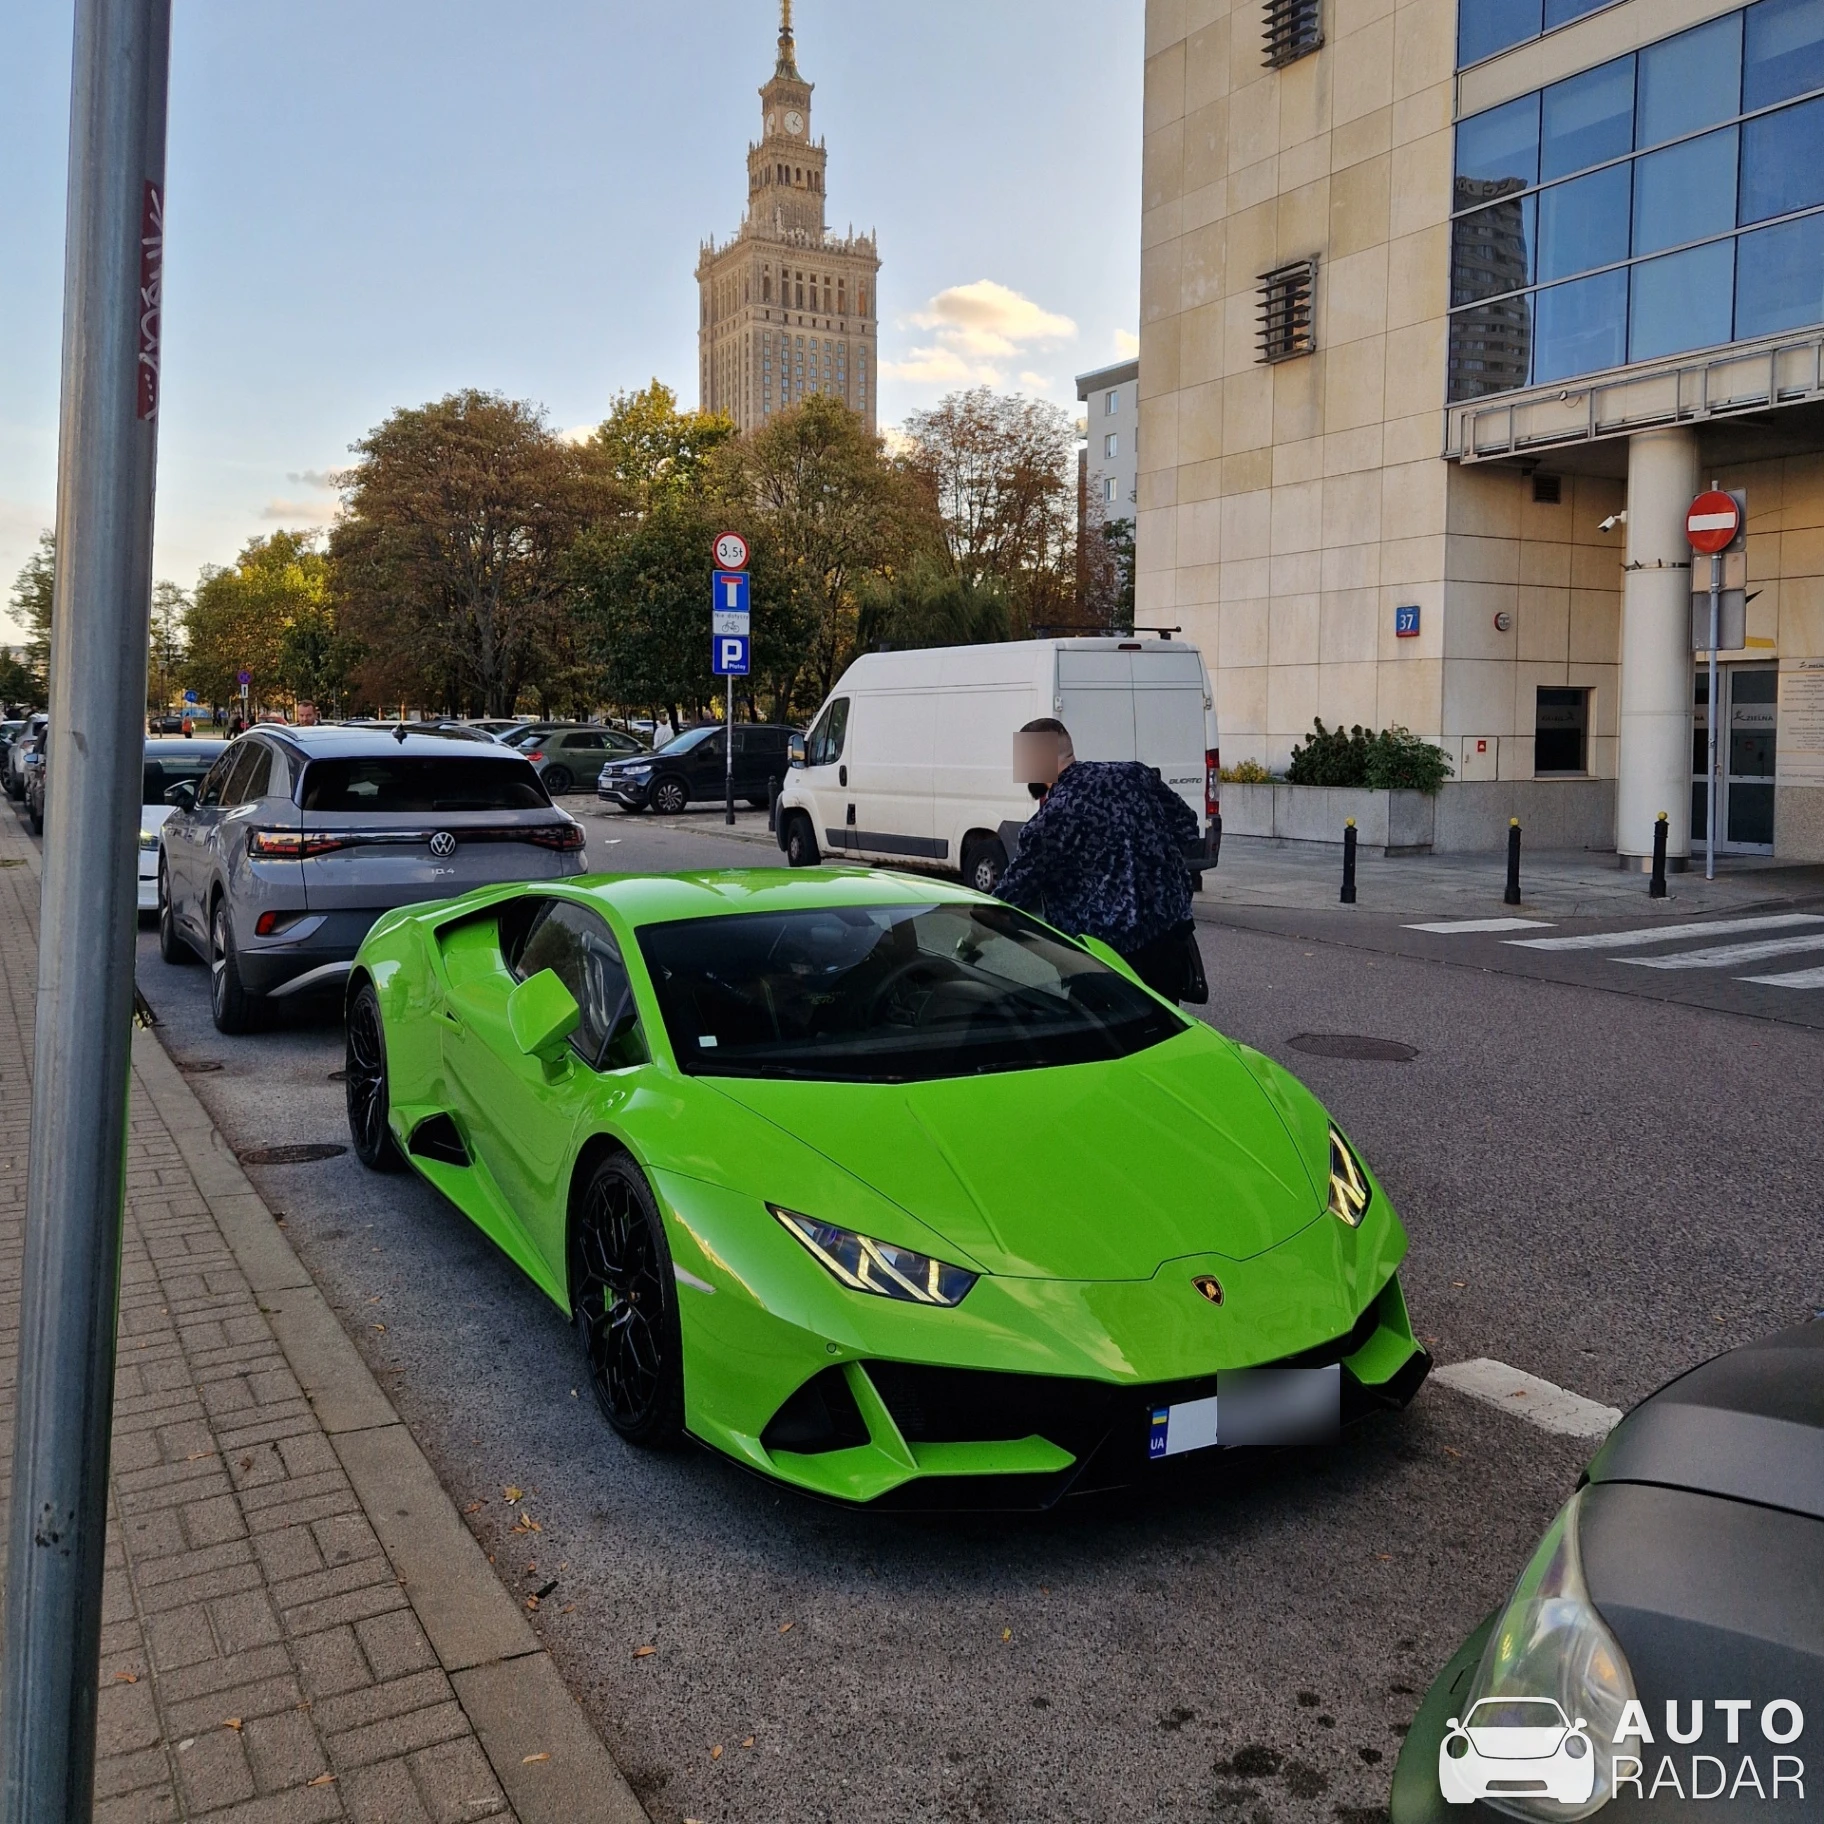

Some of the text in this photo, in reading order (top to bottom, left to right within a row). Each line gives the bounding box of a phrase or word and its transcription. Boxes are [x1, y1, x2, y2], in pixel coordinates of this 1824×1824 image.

[720, 543, 743, 558] 3,5t
[1399, 614, 1414, 630] 37
[722, 639, 742, 669] P
[1150, 1437, 1164, 1450] UA
